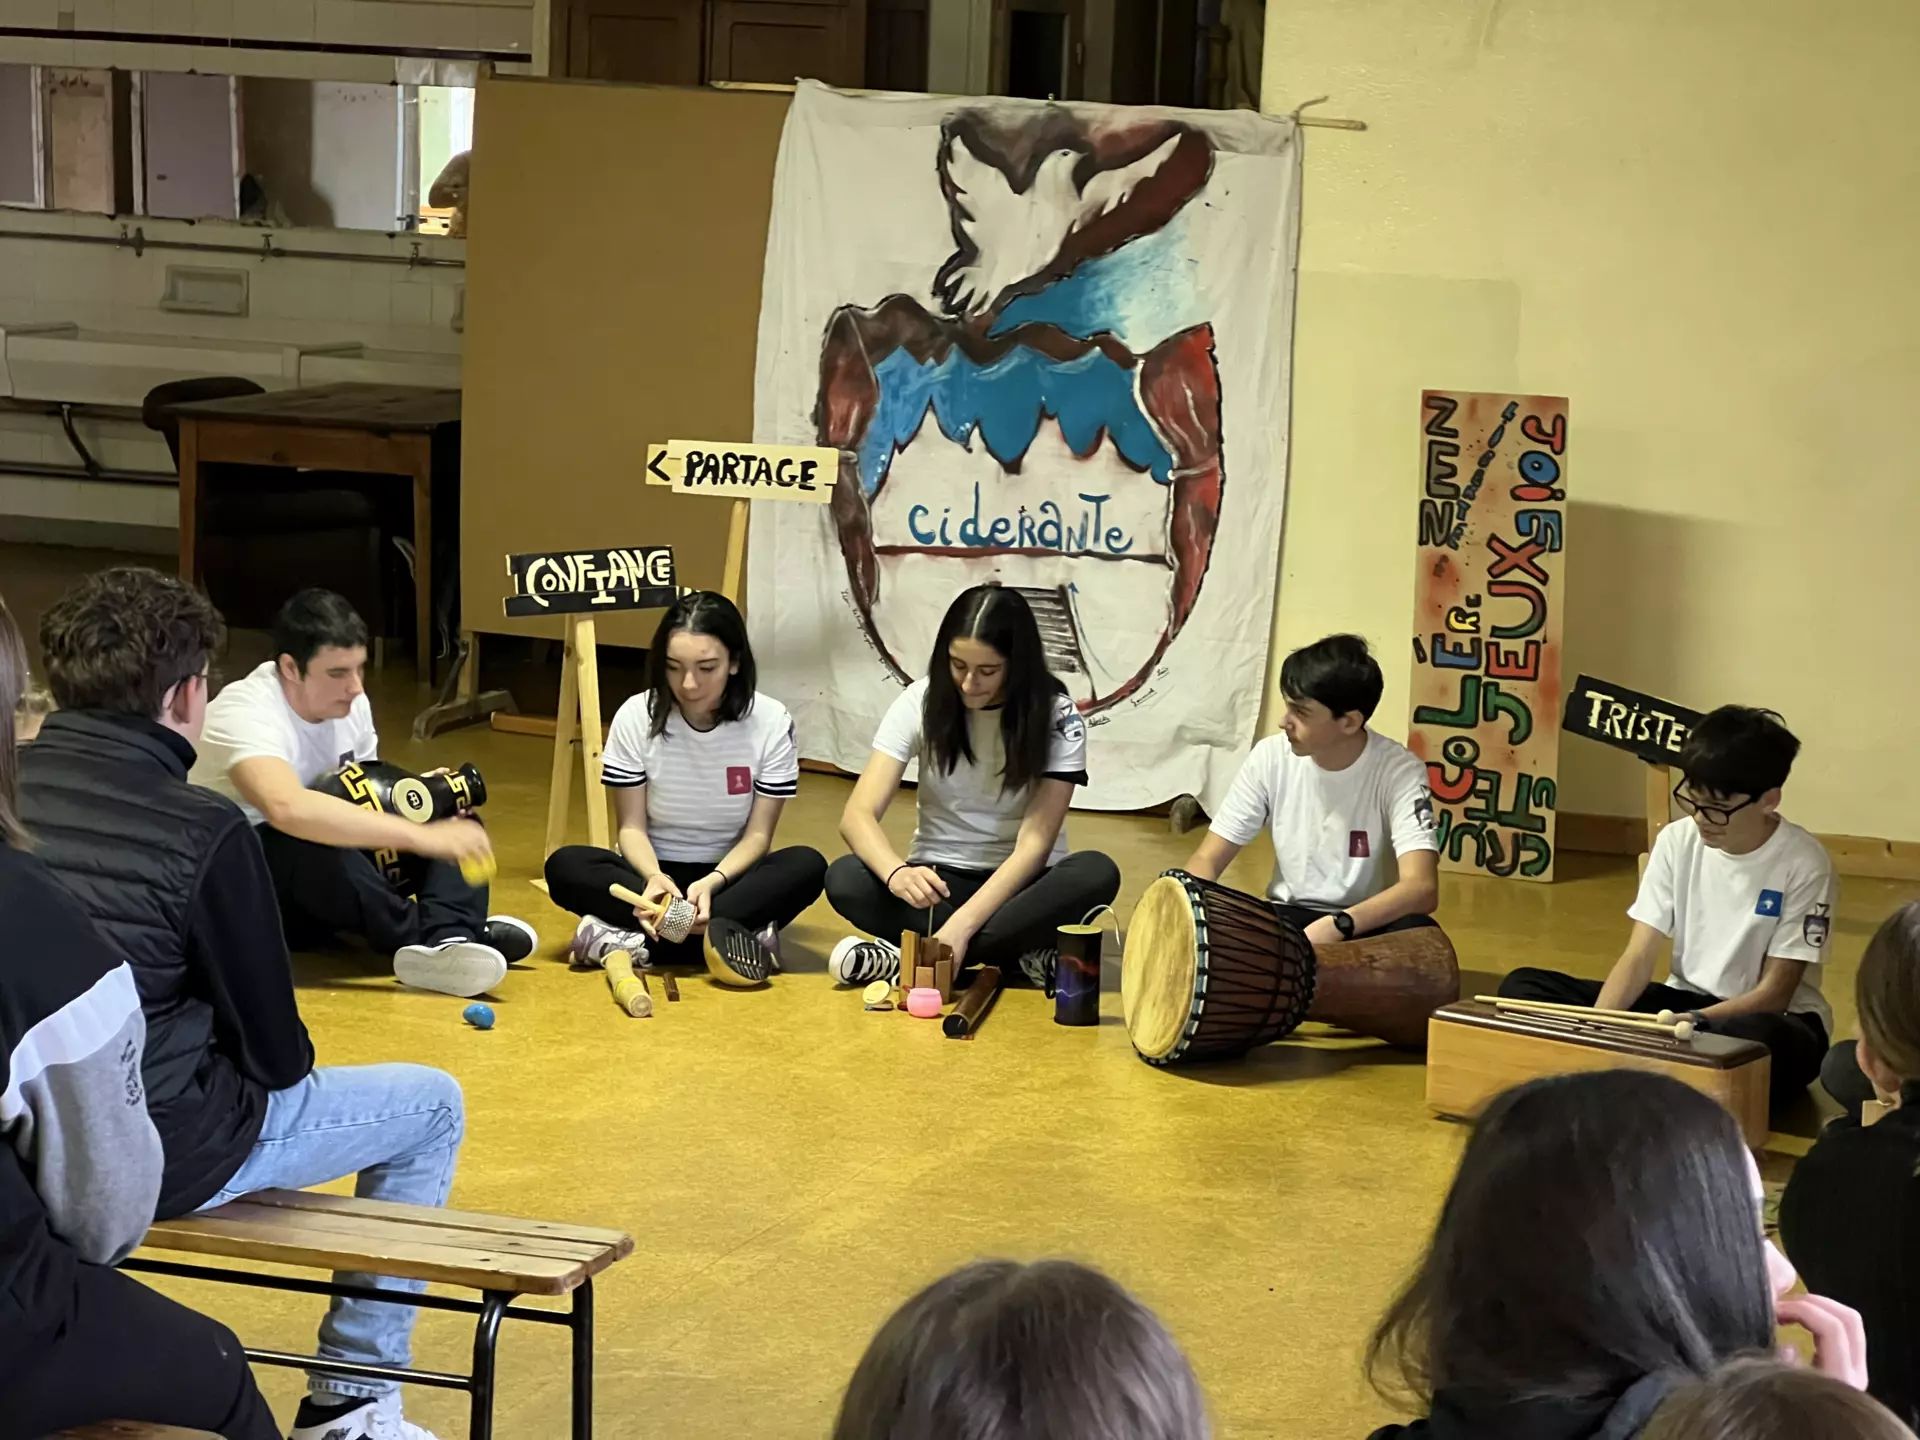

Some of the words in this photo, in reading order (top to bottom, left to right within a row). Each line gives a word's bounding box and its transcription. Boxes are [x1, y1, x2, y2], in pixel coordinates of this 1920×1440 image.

[684, 450, 819, 491] PARTAGE
[1418, 395, 1461, 547] ZEN
[526, 549, 672, 607] CONFIANCE
[1482, 532, 1550, 746] JEUX
